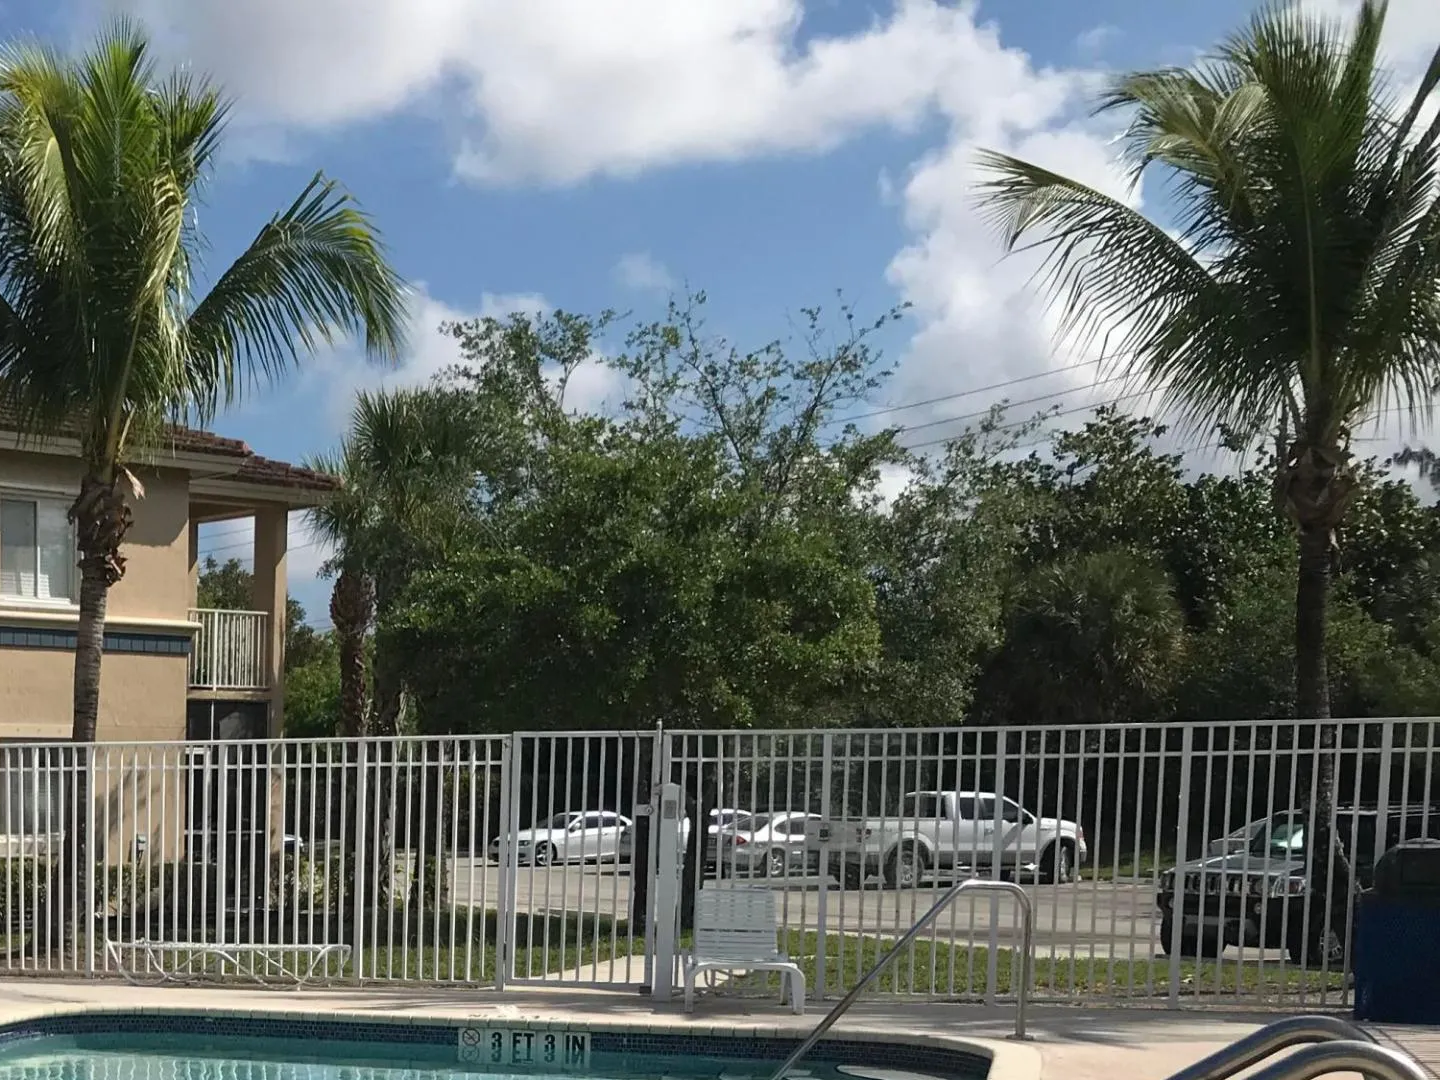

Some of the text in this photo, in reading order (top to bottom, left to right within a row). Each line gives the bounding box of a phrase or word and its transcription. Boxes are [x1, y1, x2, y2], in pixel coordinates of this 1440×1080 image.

[491, 1032, 586, 1051] 3 FT 3 IN
